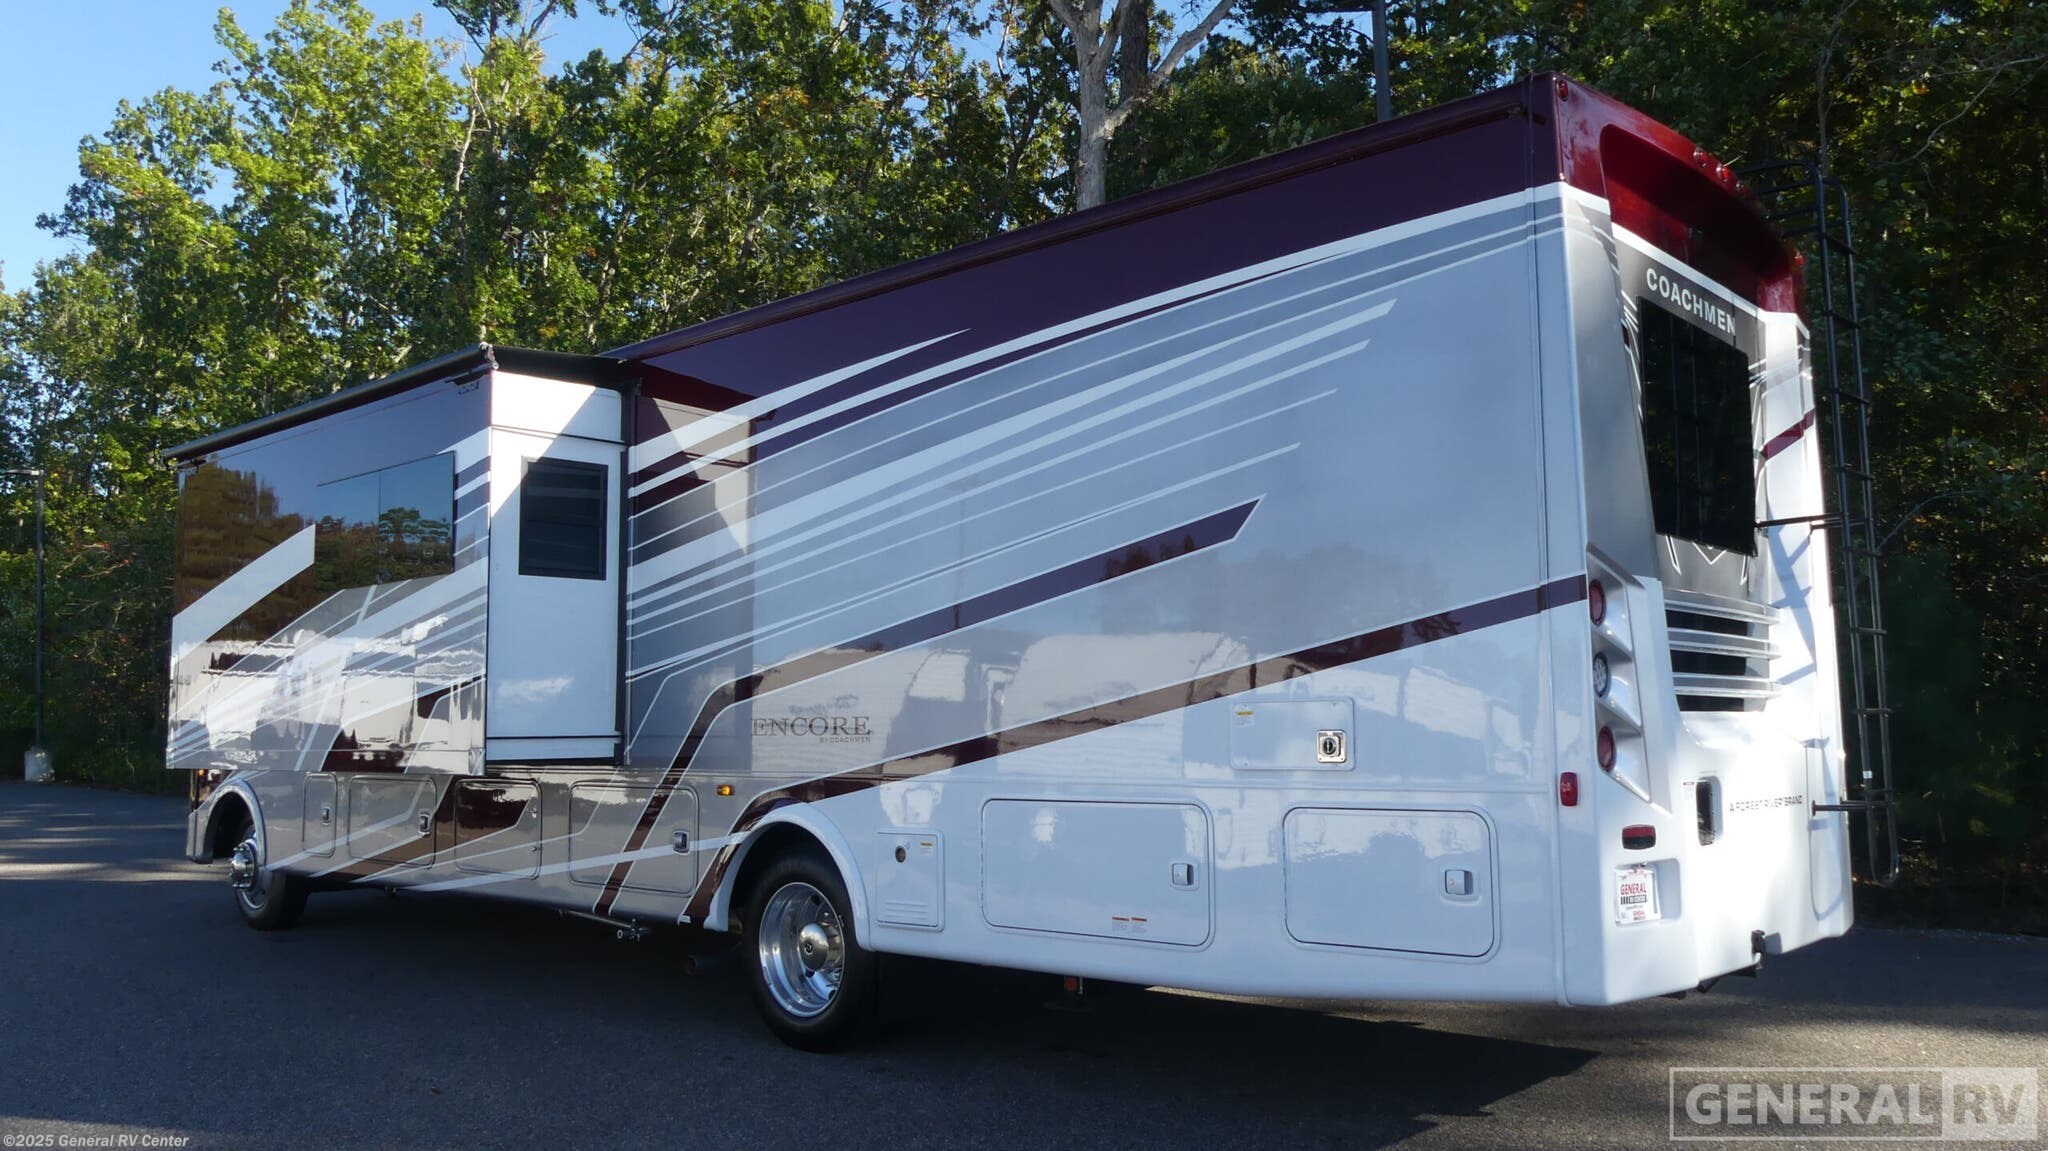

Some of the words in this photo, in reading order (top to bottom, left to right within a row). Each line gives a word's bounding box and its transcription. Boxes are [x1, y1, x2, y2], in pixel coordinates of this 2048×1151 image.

[1646, 268, 1736, 335] COACHMEN
[752, 716, 871, 736] ENCORE
[1620, 883, 1647, 895] GENERAL
